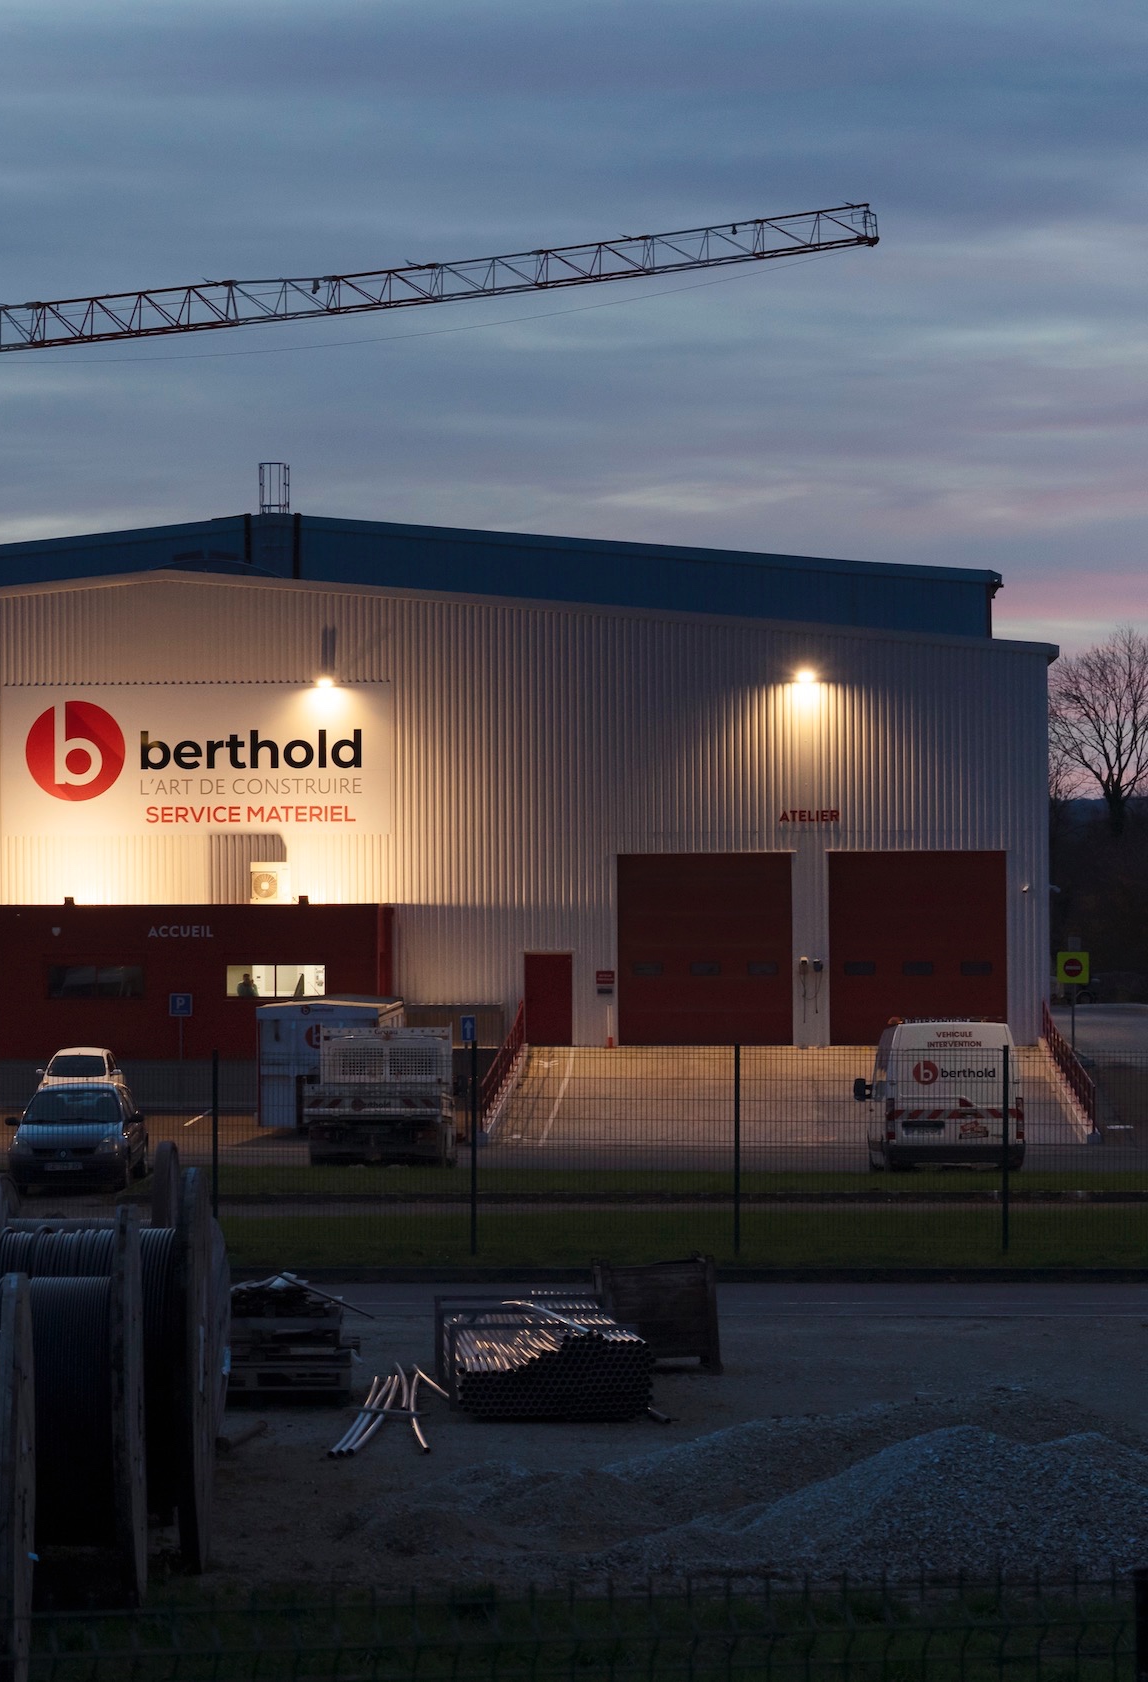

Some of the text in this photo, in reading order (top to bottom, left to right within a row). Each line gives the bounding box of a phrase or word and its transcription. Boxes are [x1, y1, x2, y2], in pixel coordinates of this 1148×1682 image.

[140, 728, 363, 770] berthold
[140, 777, 363, 796] L'ART DE CONSTRUIRE
[145, 804, 356, 824] SERVICE MATERIEL
[779, 809, 840, 823] ATELIER
[148, 925, 214, 938] ACCUEIL
[176, 997, 185, 1010] P
[940, 1068, 996, 1078] berthold
